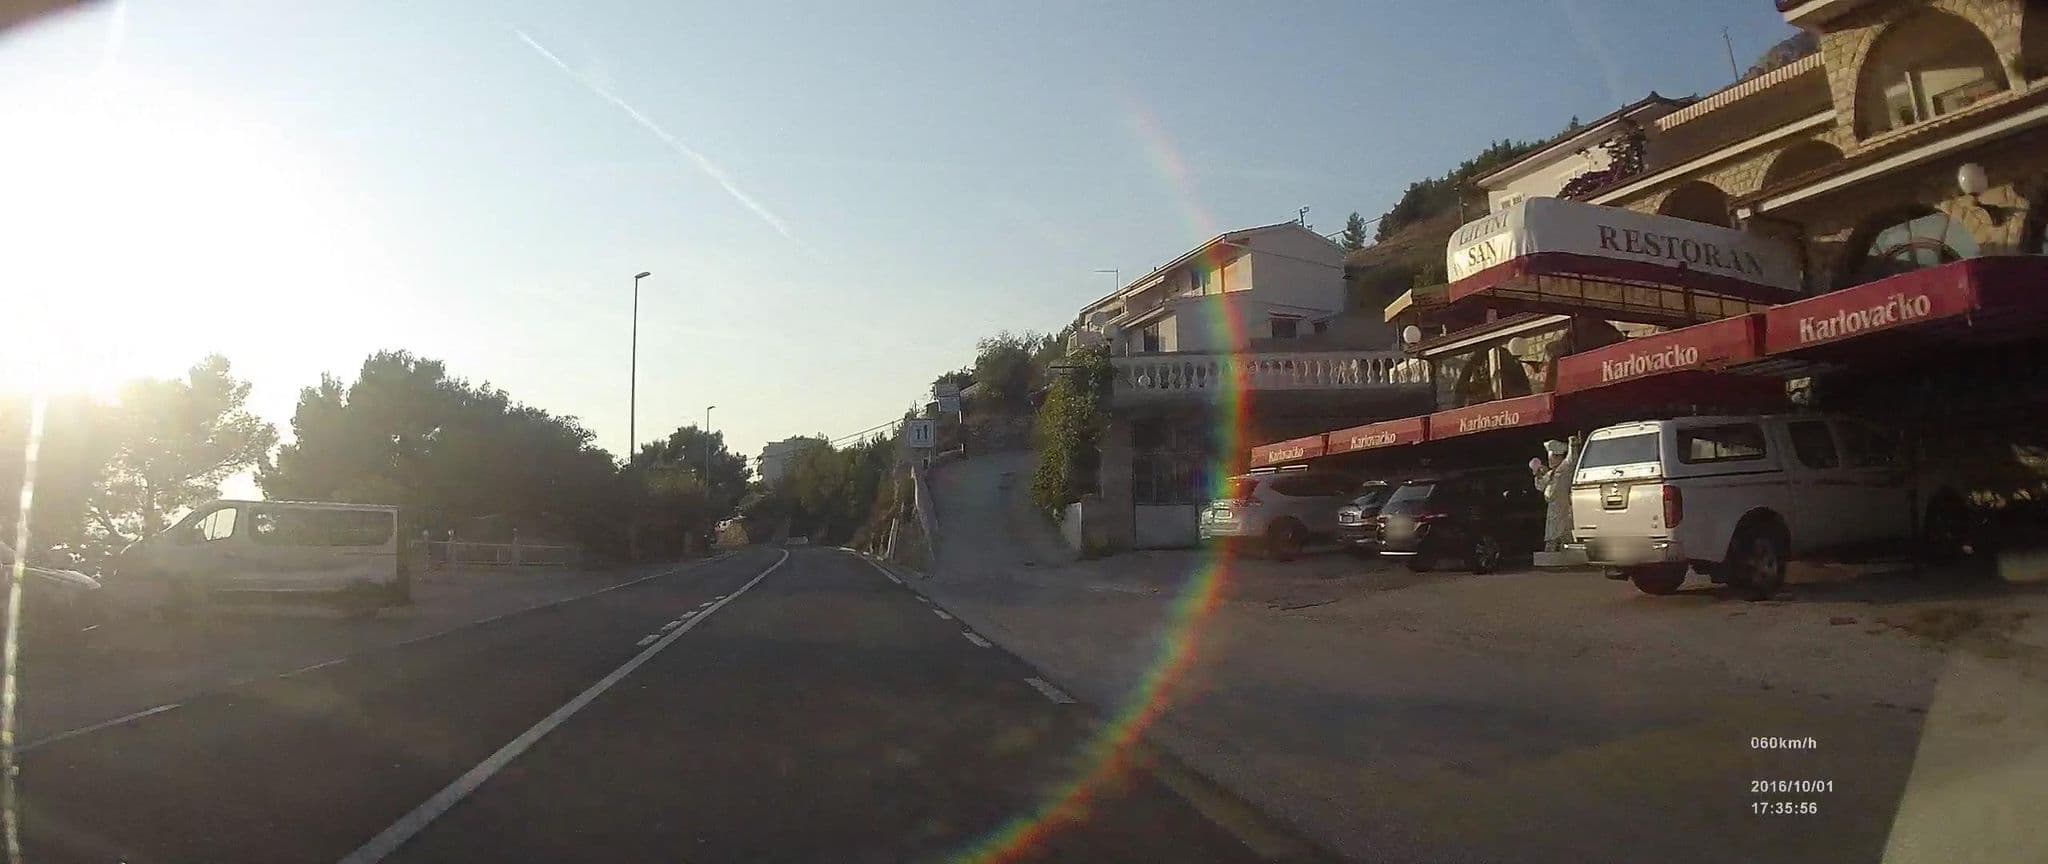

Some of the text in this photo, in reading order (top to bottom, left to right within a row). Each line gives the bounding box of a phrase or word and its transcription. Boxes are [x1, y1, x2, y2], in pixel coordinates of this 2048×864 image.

[1598, 225, 1764, 278] RESTORAN
[1800, 293, 1931, 343] Karlovačko
[1602, 344, 1699, 382] Karlovačko
[1459, 410, 1520, 432] Karlovačko
